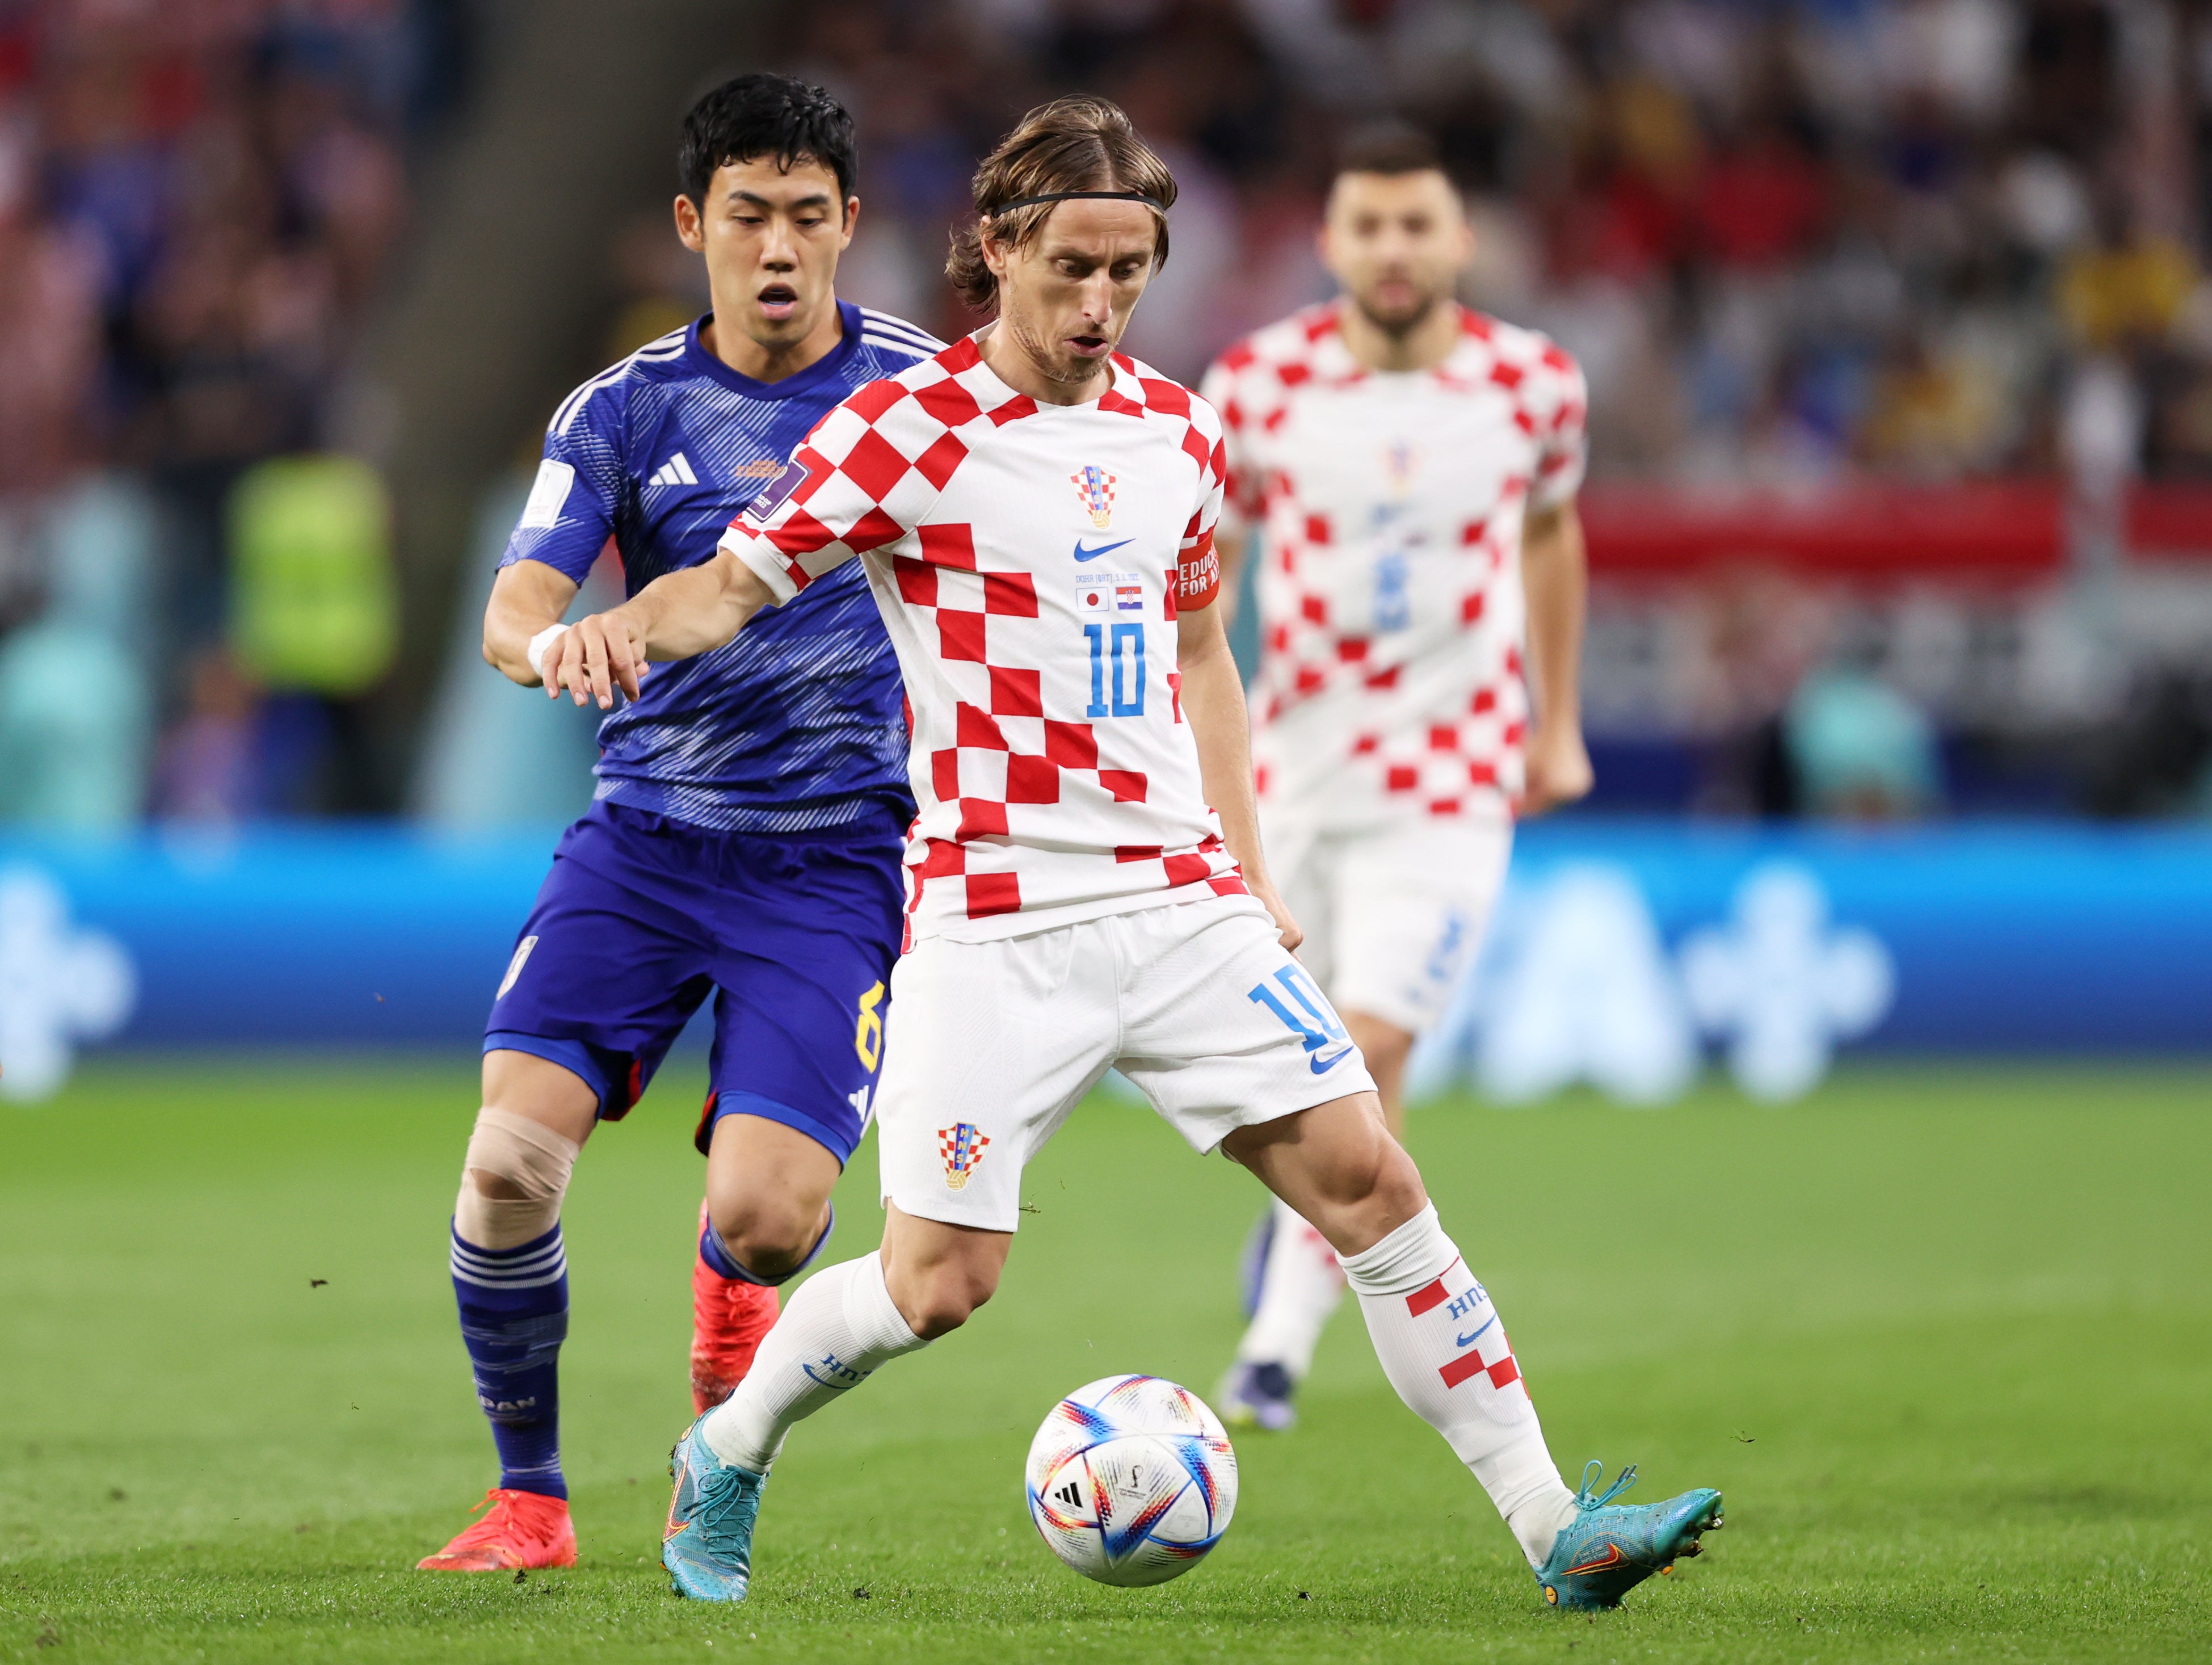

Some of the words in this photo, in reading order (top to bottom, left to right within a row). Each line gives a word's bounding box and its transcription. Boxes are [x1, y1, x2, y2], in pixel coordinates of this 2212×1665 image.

[1076, 574, 1094, 583] DOHA
[1180, 575, 1208, 598] FOR
[1083, 623, 1146, 718] 10
[855, 979, 885, 1074] 6
[1247, 963, 1348, 1053] 10
[956, 1128, 970, 1164] HNS
